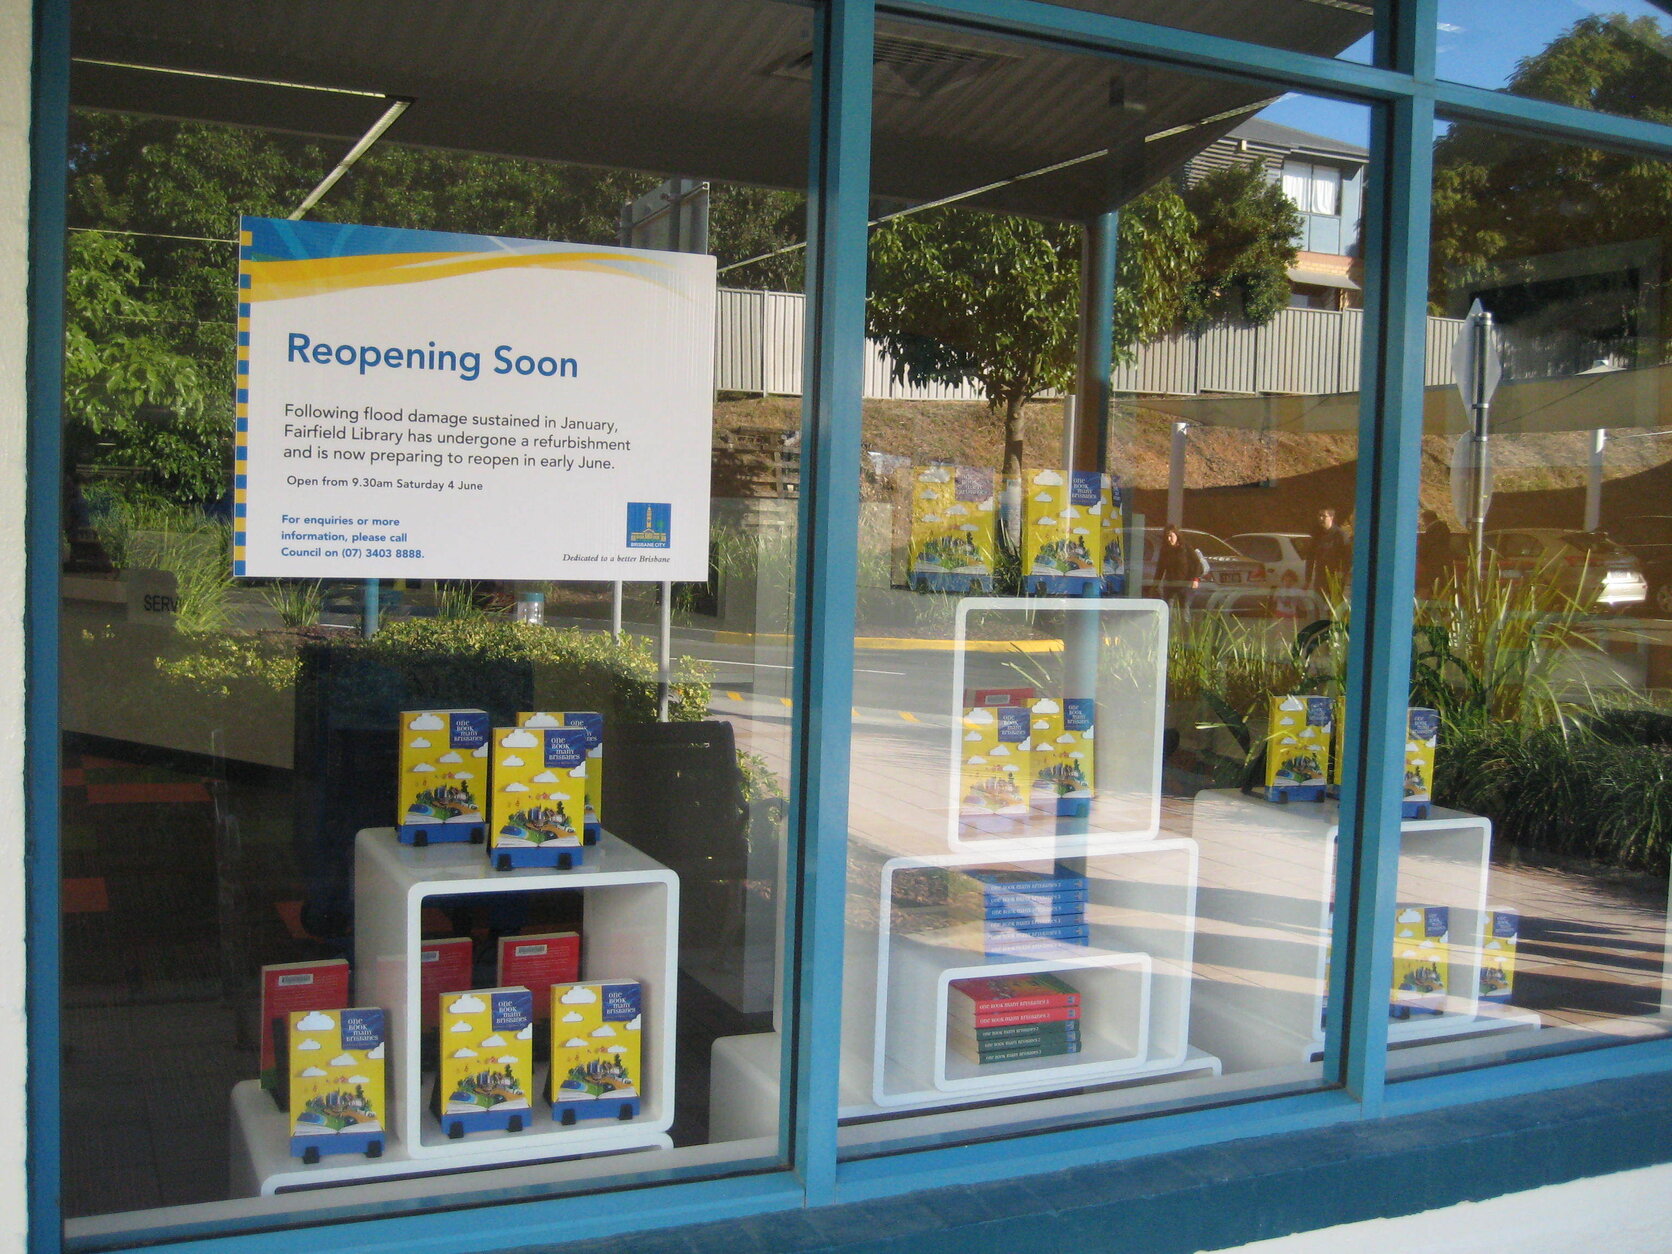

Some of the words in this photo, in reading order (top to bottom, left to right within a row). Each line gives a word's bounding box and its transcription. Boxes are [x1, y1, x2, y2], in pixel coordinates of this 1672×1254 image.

[287, 333, 481, 382] Reopening
[493, 345, 578, 379] Soon
[285, 403, 359, 423] Following
[363, 406, 403, 422] flood
[408, 409, 468, 428] damage
[472, 413, 540, 428] sustained
[545, 416, 557, 429] in
[561, 417, 618, 435] January,
[284, 424, 346, 440] Fairfield
[352, 427, 403, 445] Library
[408, 429, 432, 443] has
[437, 431, 516, 449] undergone
[521, 438, 529, 447] a
[534, 435, 631, 451] refurbishment
[283, 445, 312, 459] and
[317, 446, 328, 460] is
[333, 449, 366, 461] now
[370, 449, 443, 467] preparing
[447, 453, 463, 465] to
[468, 454, 519, 469] reopen
[524, 454, 536, 467] in
[541, 455, 574, 472] early
[578, 456, 615, 470] June.
[287, 475, 319, 488] Open
[322, 476, 349, 487] from
[352, 477, 393, 488] 9.30am
[397, 479, 445, 492] Saturday
[448, 481, 455, 490] 4
[458, 481, 483, 490] June
[281, 514, 301, 524] For
[304, 516, 354, 527] enquiries
[281, 531, 348, 542] information,
[352, 532, 387, 543] please
[389, 533, 408, 542] call
[281, 547, 321, 557] Council
[342, 548, 362, 559] (07)
[366, 549, 392, 558] 3403
[395, 549, 425, 559] 8888.
[639, 555, 671, 563] Brisbane
